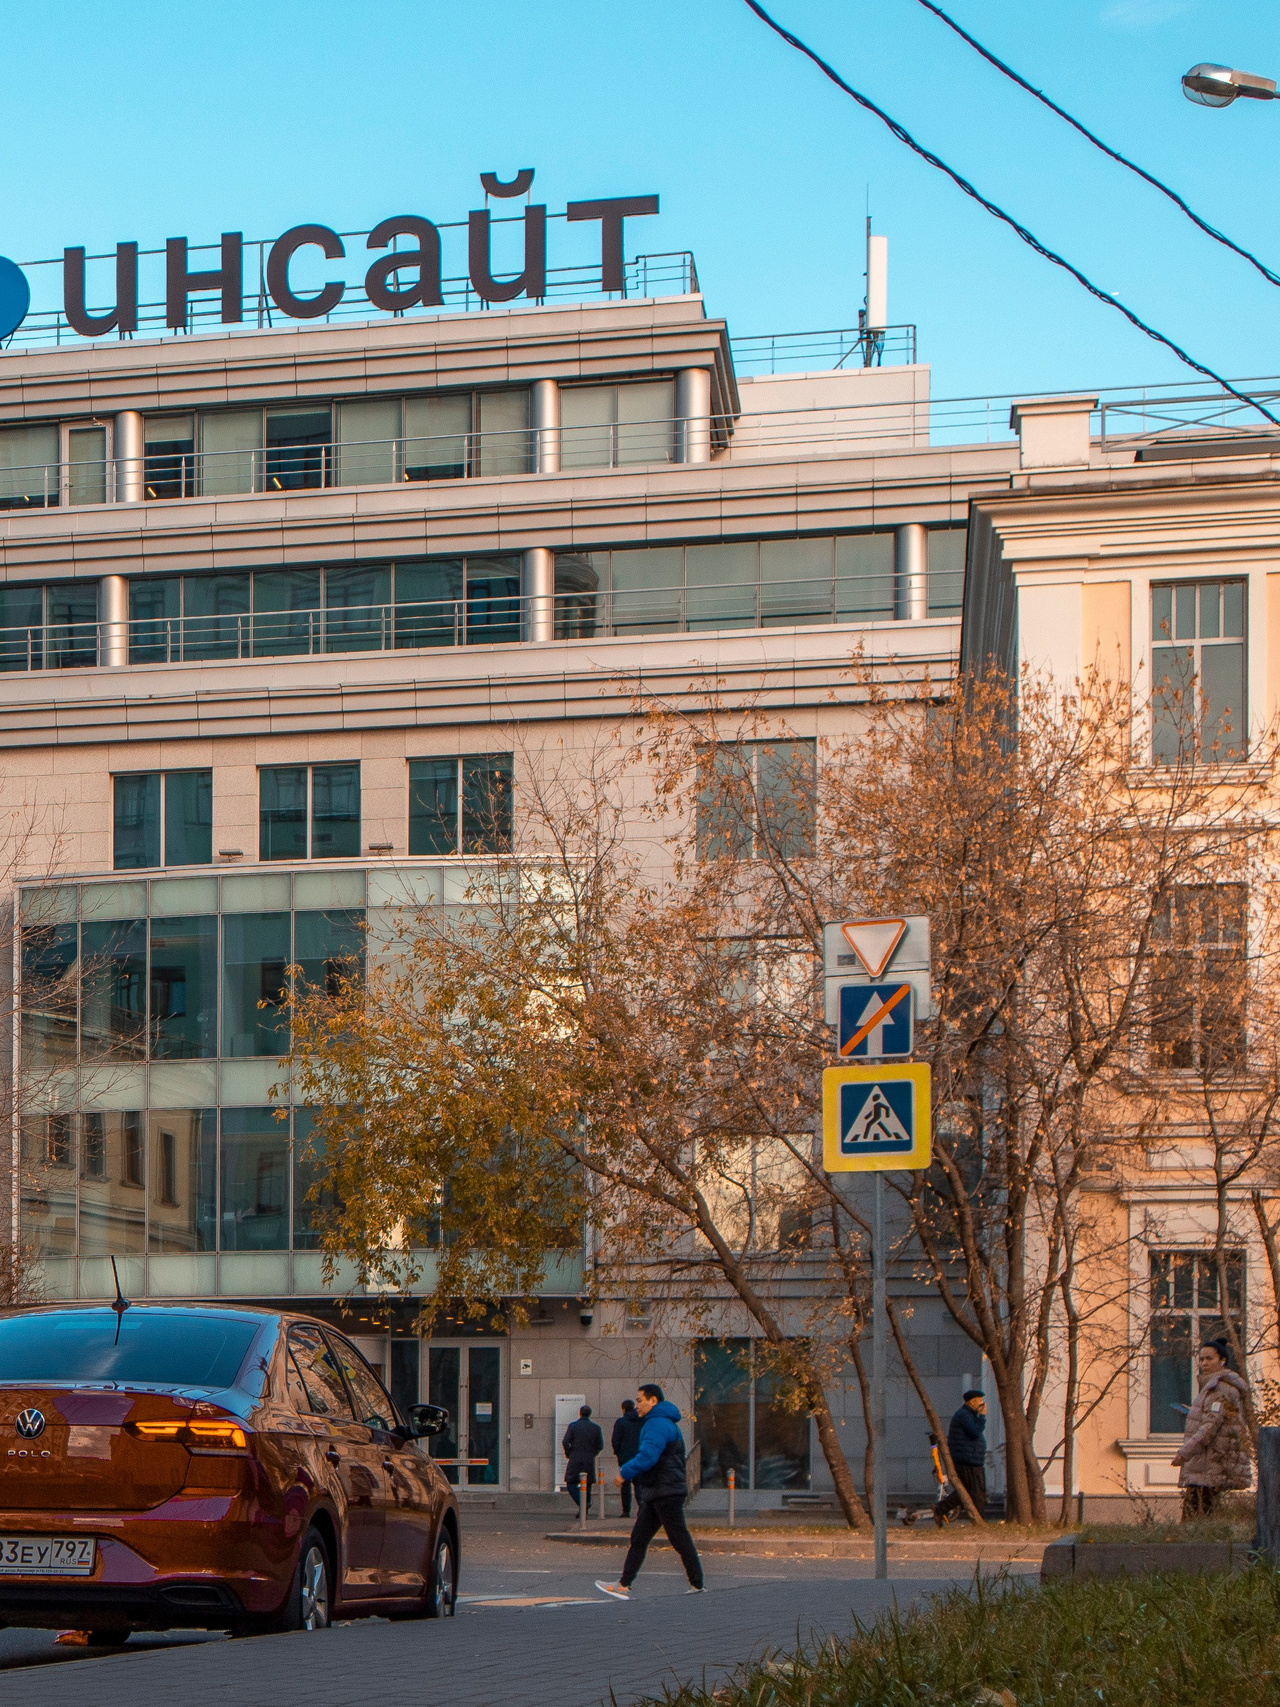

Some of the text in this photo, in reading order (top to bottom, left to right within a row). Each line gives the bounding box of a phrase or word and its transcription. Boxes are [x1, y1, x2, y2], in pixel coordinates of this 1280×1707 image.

[64, 167, 660, 337] инсайт
[7, 1449, 51, 1457] POLO
[53, 1540, 89, 1559] 797
